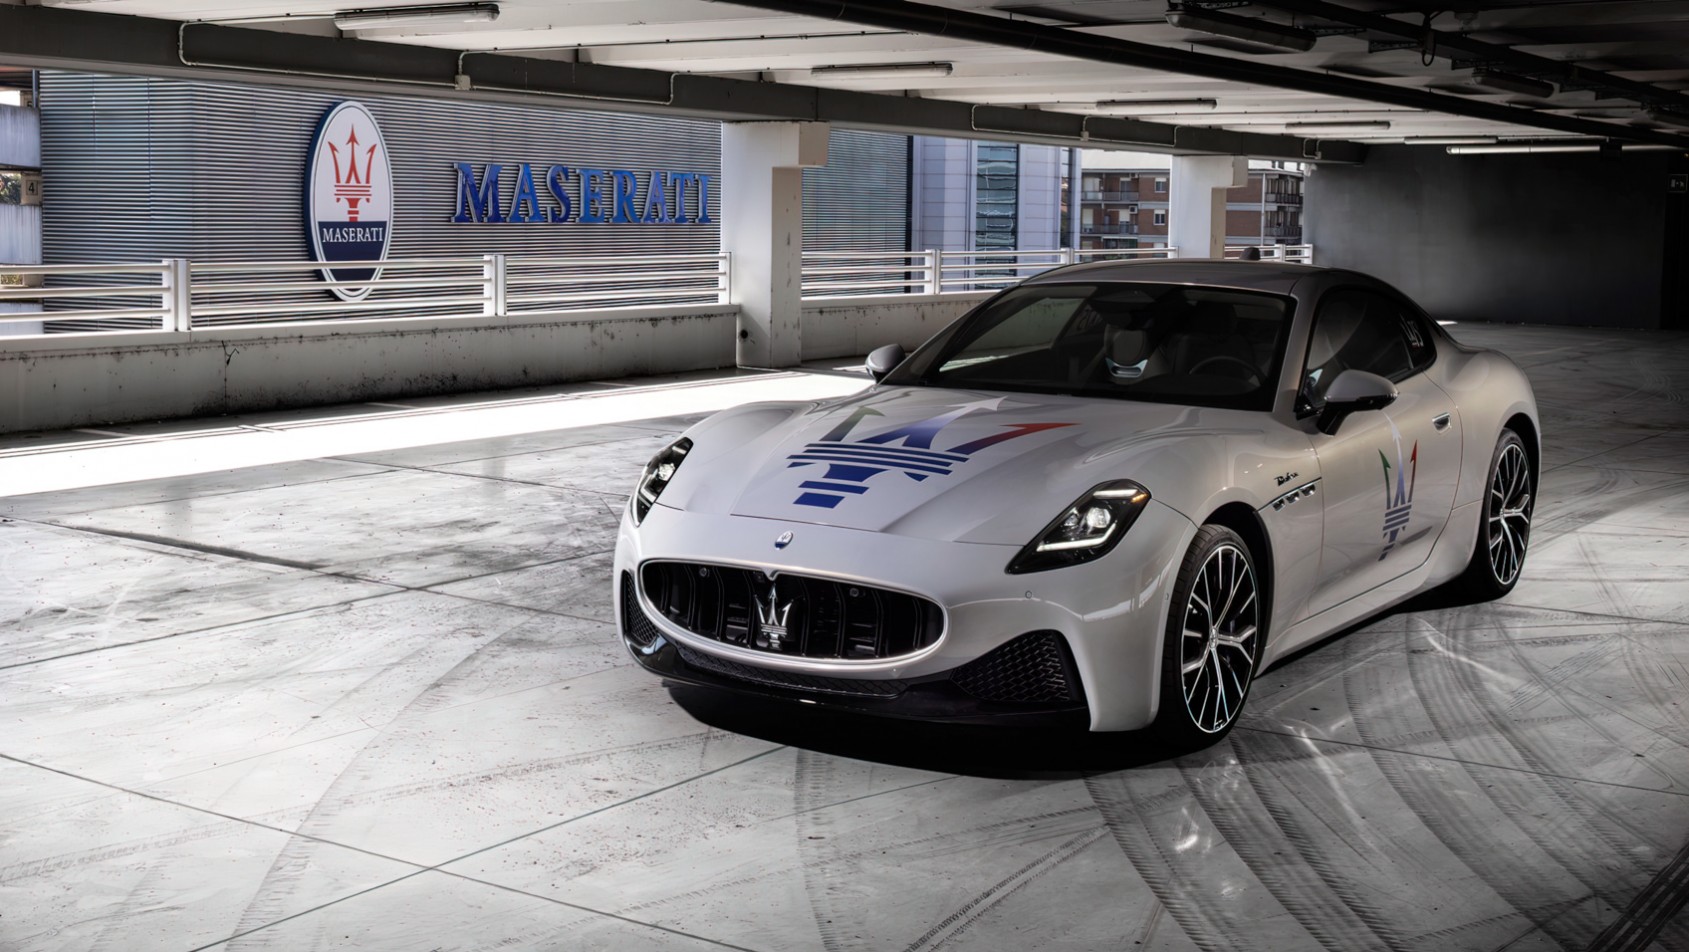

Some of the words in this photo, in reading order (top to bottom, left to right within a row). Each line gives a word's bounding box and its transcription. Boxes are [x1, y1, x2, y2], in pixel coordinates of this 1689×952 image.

[28, 182, 35, 194] 4
[451, 162, 713, 223] MASERATI
[322, 227, 384, 243] MASERATI
